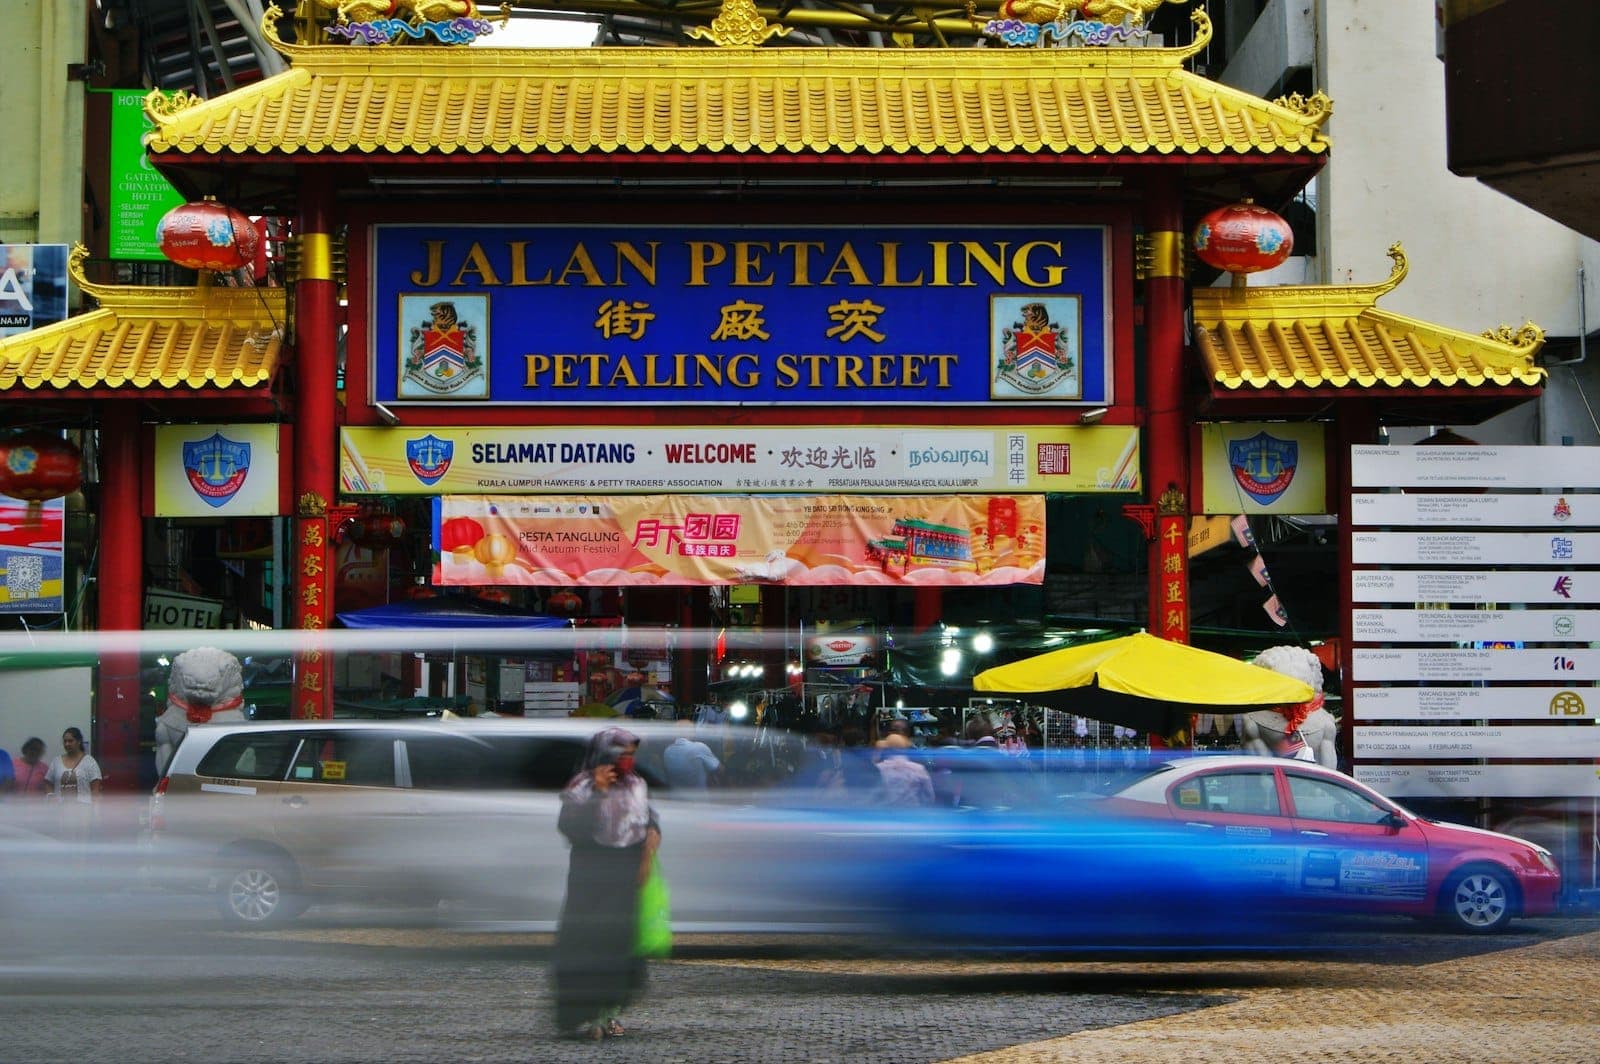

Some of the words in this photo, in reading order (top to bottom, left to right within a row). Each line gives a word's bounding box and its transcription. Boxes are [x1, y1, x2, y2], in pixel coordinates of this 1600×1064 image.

[132, 192, 163, 200] HOTEL
[410, 240, 660, 286] JALAN
[684, 239, 1068, 288] PETALING
[524, 353, 761, 389] PETALING
[775, 353, 958, 389] STREET
[472, 443, 554, 464] SELAMAT
[562, 443, 636, 464] DATANG
[664, 443, 756, 464] WELCOME
[780, 446, 876, 470] 欢迎光临
[1009, 436, 1025, 484] 丙申年
[520, 532, 554, 542] PESTA
[557, 532, 620, 542] TANGLUNG
[632, 513, 740, 554] 月下团圆
[520, 544, 537, 553] Mid
[541, 545, 580, 553] Autumn
[584, 544, 620, 553] Festival
[147, 604, 218, 630] HOTEL
